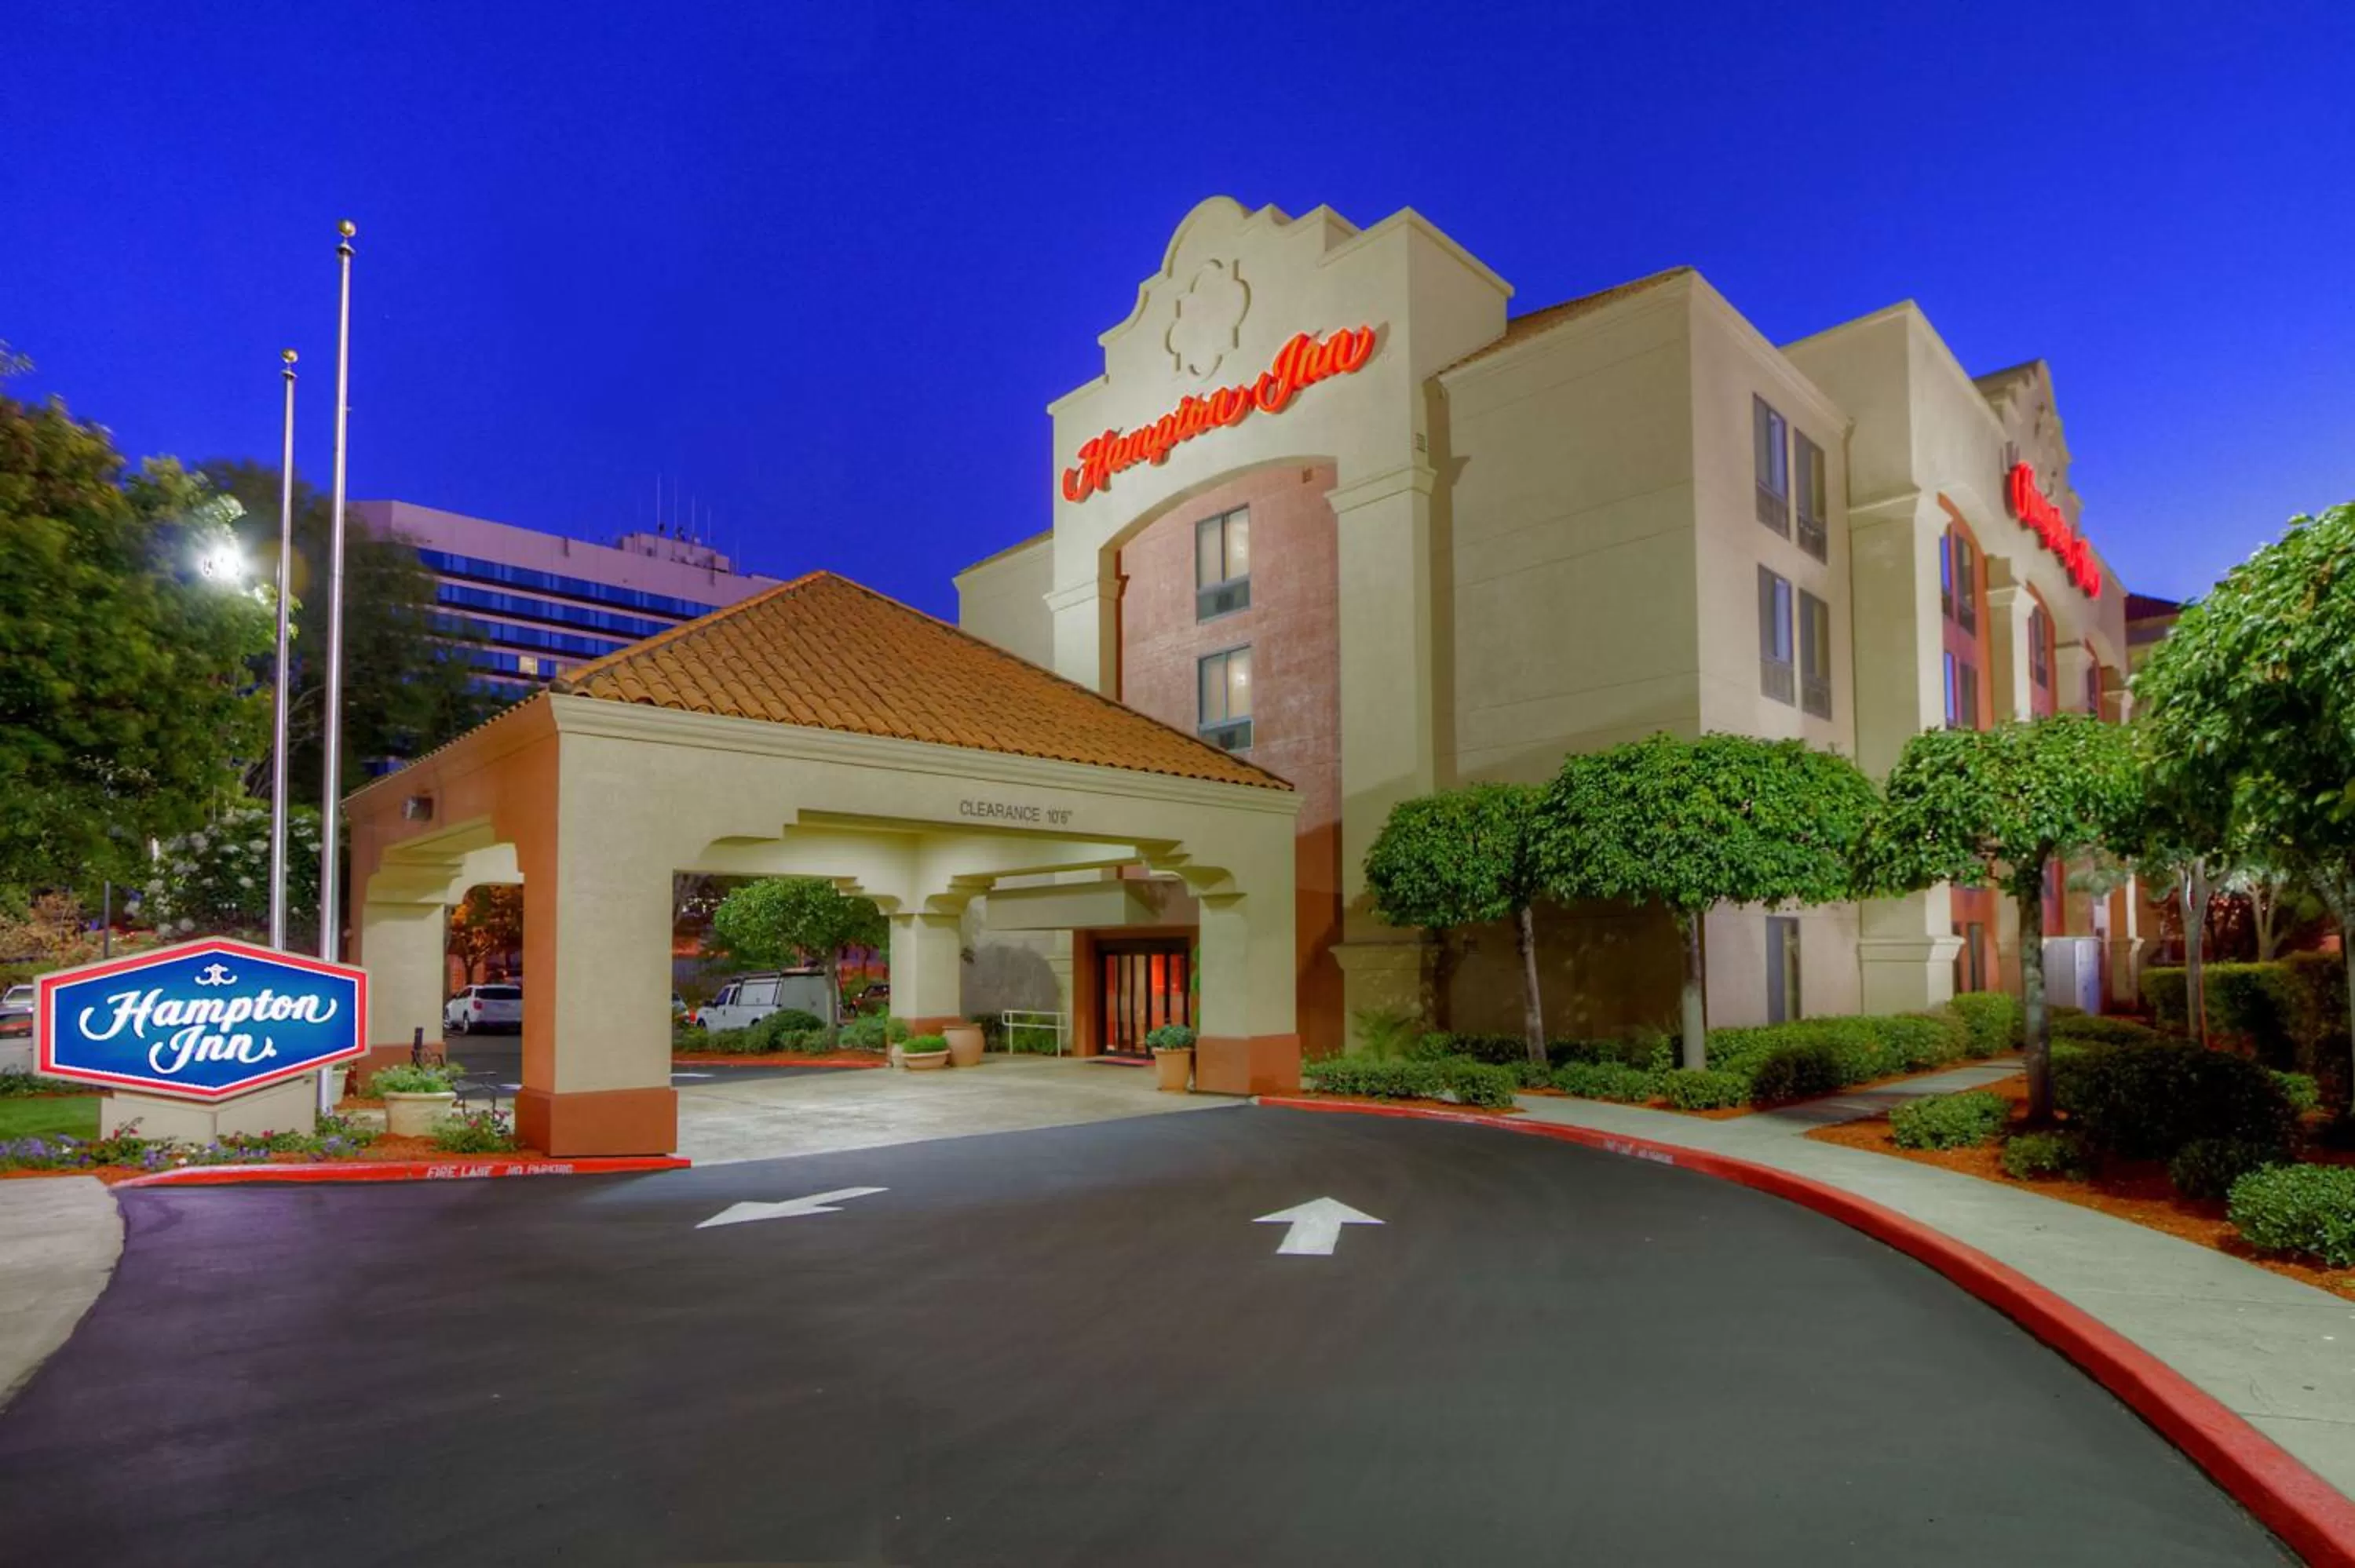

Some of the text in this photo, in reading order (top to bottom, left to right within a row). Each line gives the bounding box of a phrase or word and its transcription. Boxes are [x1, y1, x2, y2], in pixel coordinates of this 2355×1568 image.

[1062, 324, 1376, 503] Hampton Inn
[959, 799, 1040, 822] CLEARANCE
[78, 987, 338, 1041] Hampton
[148, 1024, 274, 1074] Inn
